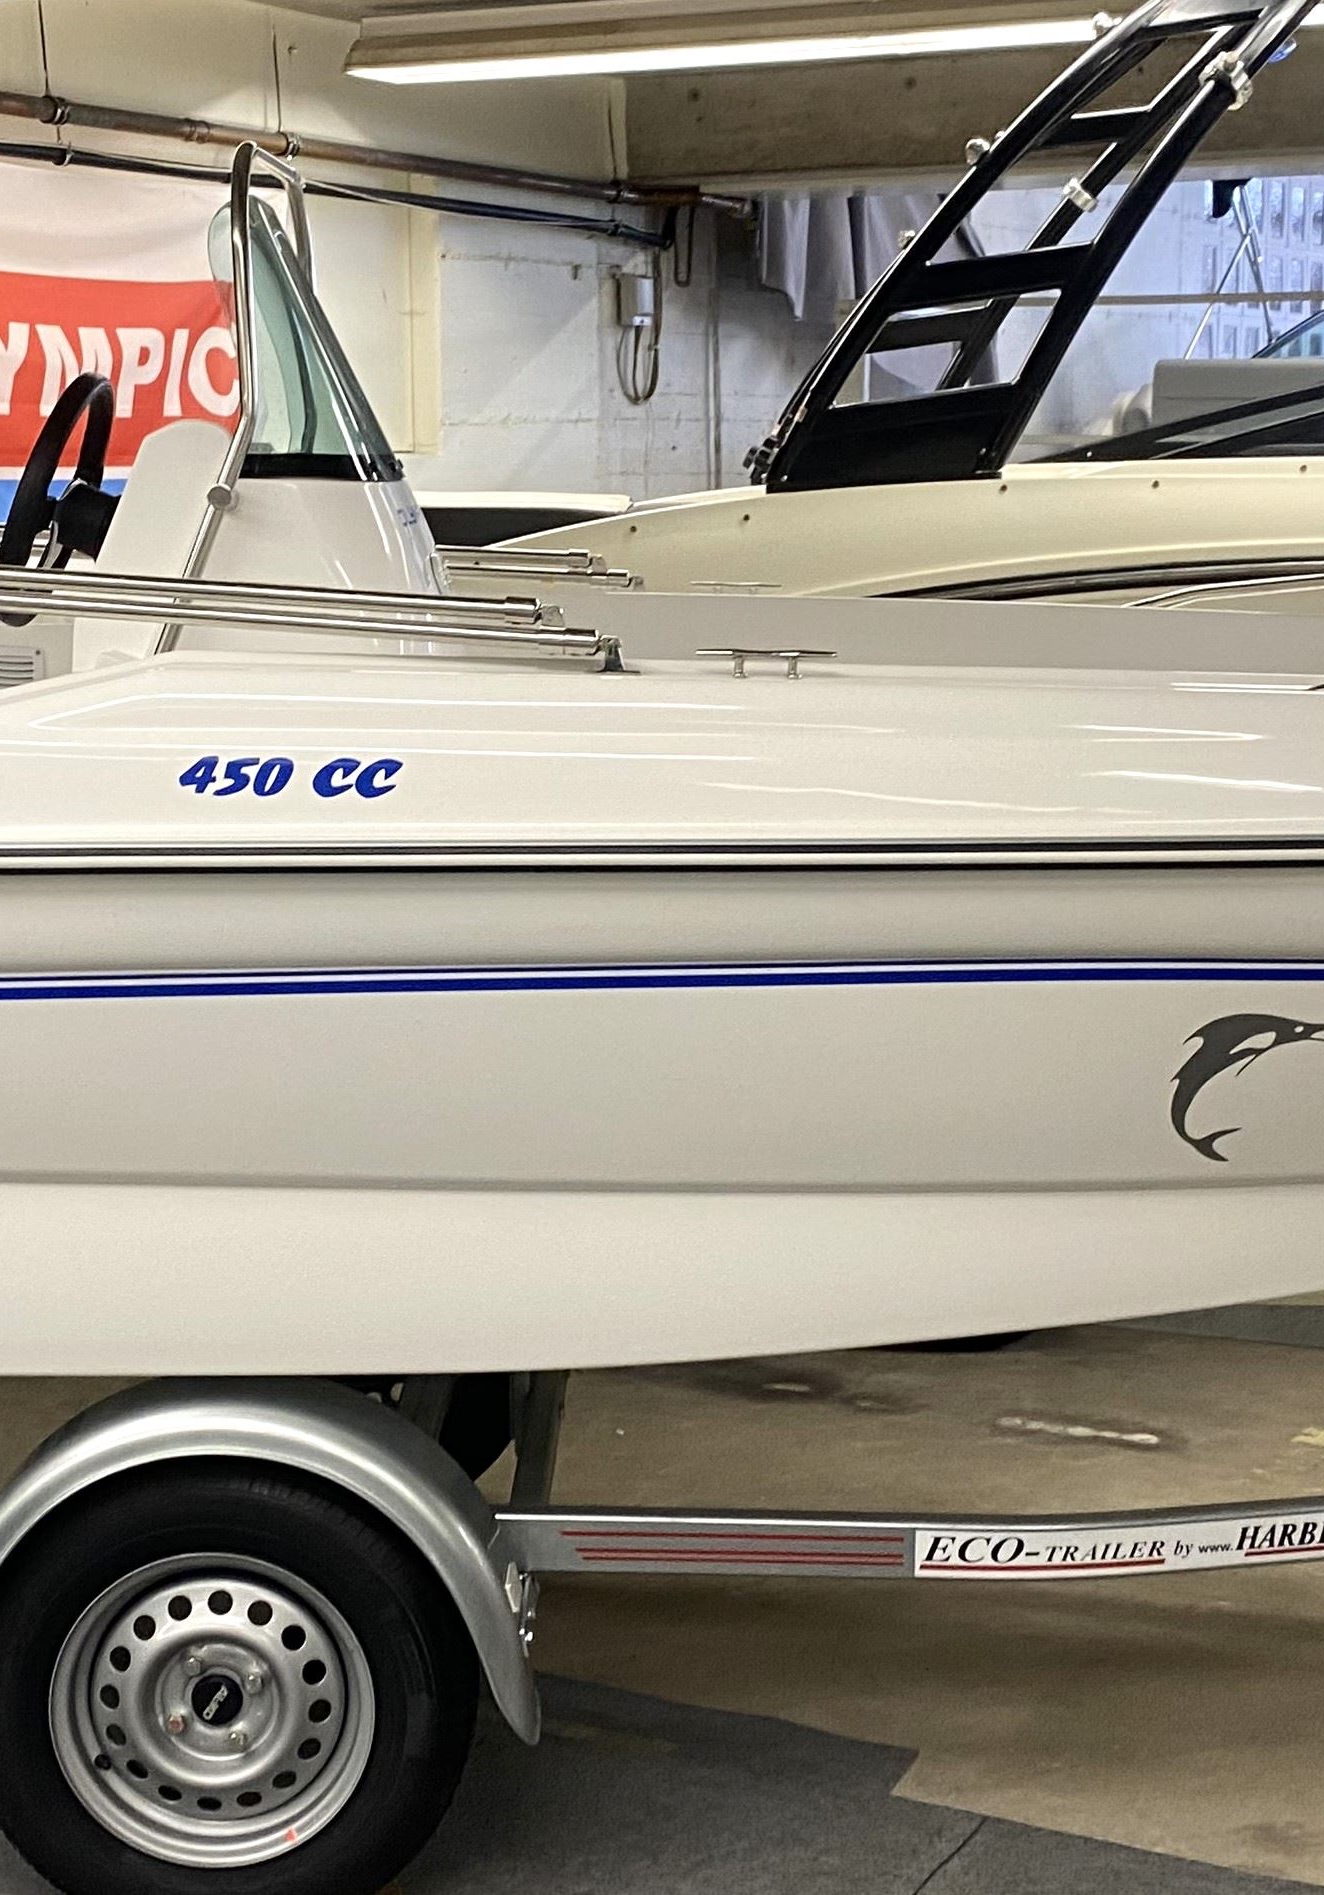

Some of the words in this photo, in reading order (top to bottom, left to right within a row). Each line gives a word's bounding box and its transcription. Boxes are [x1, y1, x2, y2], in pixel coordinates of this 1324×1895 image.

[179, 756, 294, 797] 450
[312, 757, 404, 799] CC
[924, 1536, 1166, 1564] ECO-TRAILER
[1174, 1540, 1194, 1559] by
